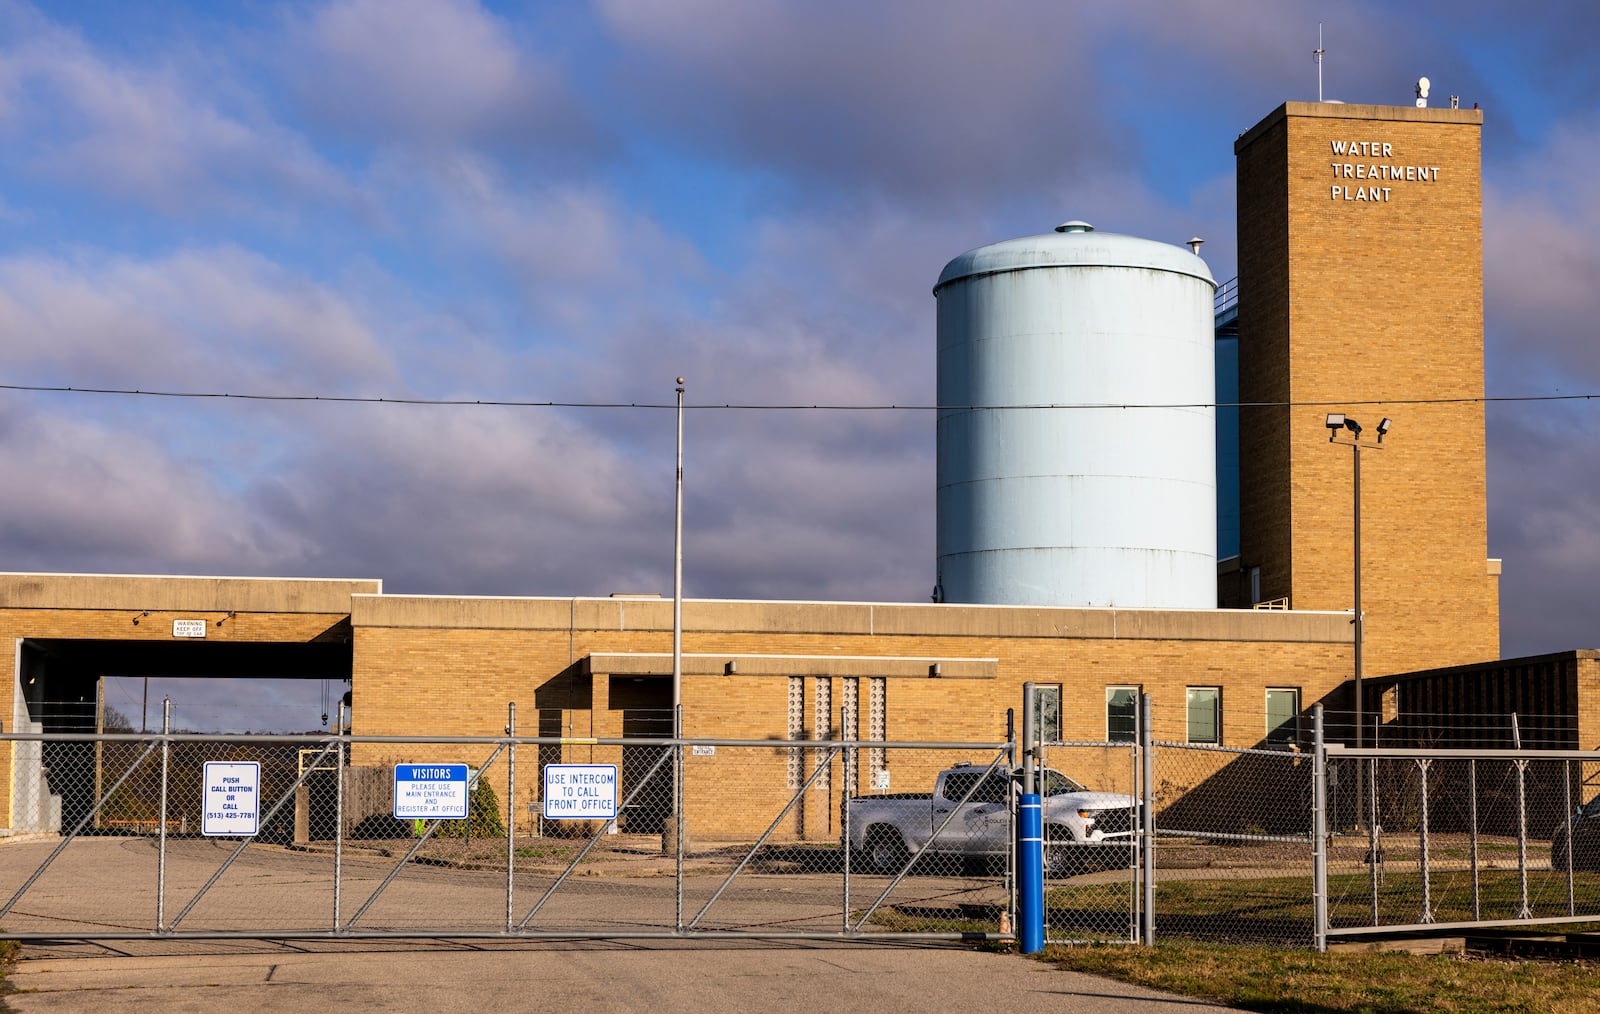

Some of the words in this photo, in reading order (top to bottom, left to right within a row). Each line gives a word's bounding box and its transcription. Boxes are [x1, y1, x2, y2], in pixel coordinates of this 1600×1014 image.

[1331, 140, 1392, 157] WATER
[1331, 163, 1440, 181] TREATMENT
[1331, 185, 1392, 202] PLANT
[412, 768, 451, 779] VISITORS
[548, 774, 566, 784] USE
[569, 774, 613, 784] INTERCOM
[562, 787, 573, 796] TO
[577, 787, 599, 796] CALL
[549, 800, 577, 809] FRONT
[581, 800, 612, 809] OFFICE
